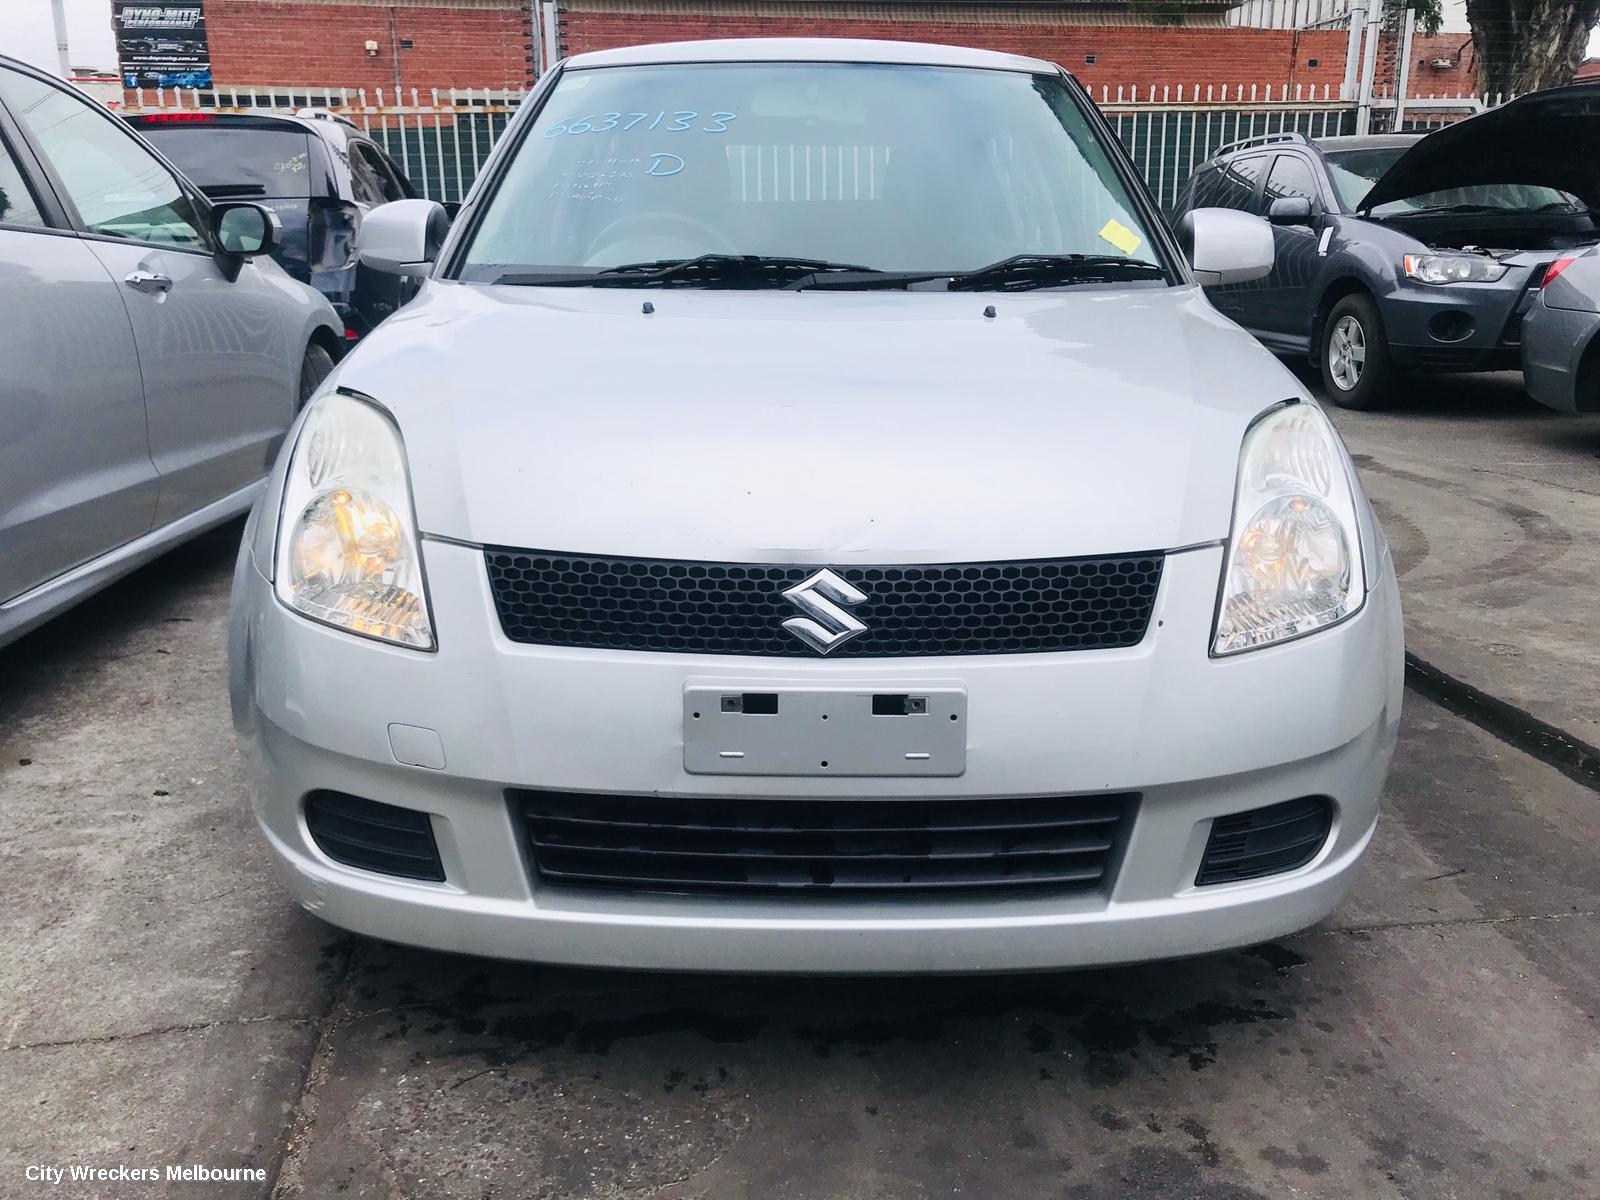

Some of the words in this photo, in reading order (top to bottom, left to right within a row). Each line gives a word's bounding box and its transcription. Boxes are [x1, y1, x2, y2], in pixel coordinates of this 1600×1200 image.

[122, 9, 199, 21] DYNO-MITE
[126, 19, 196, 28] PERFORMANCE
[645, 152, 685, 176] D
